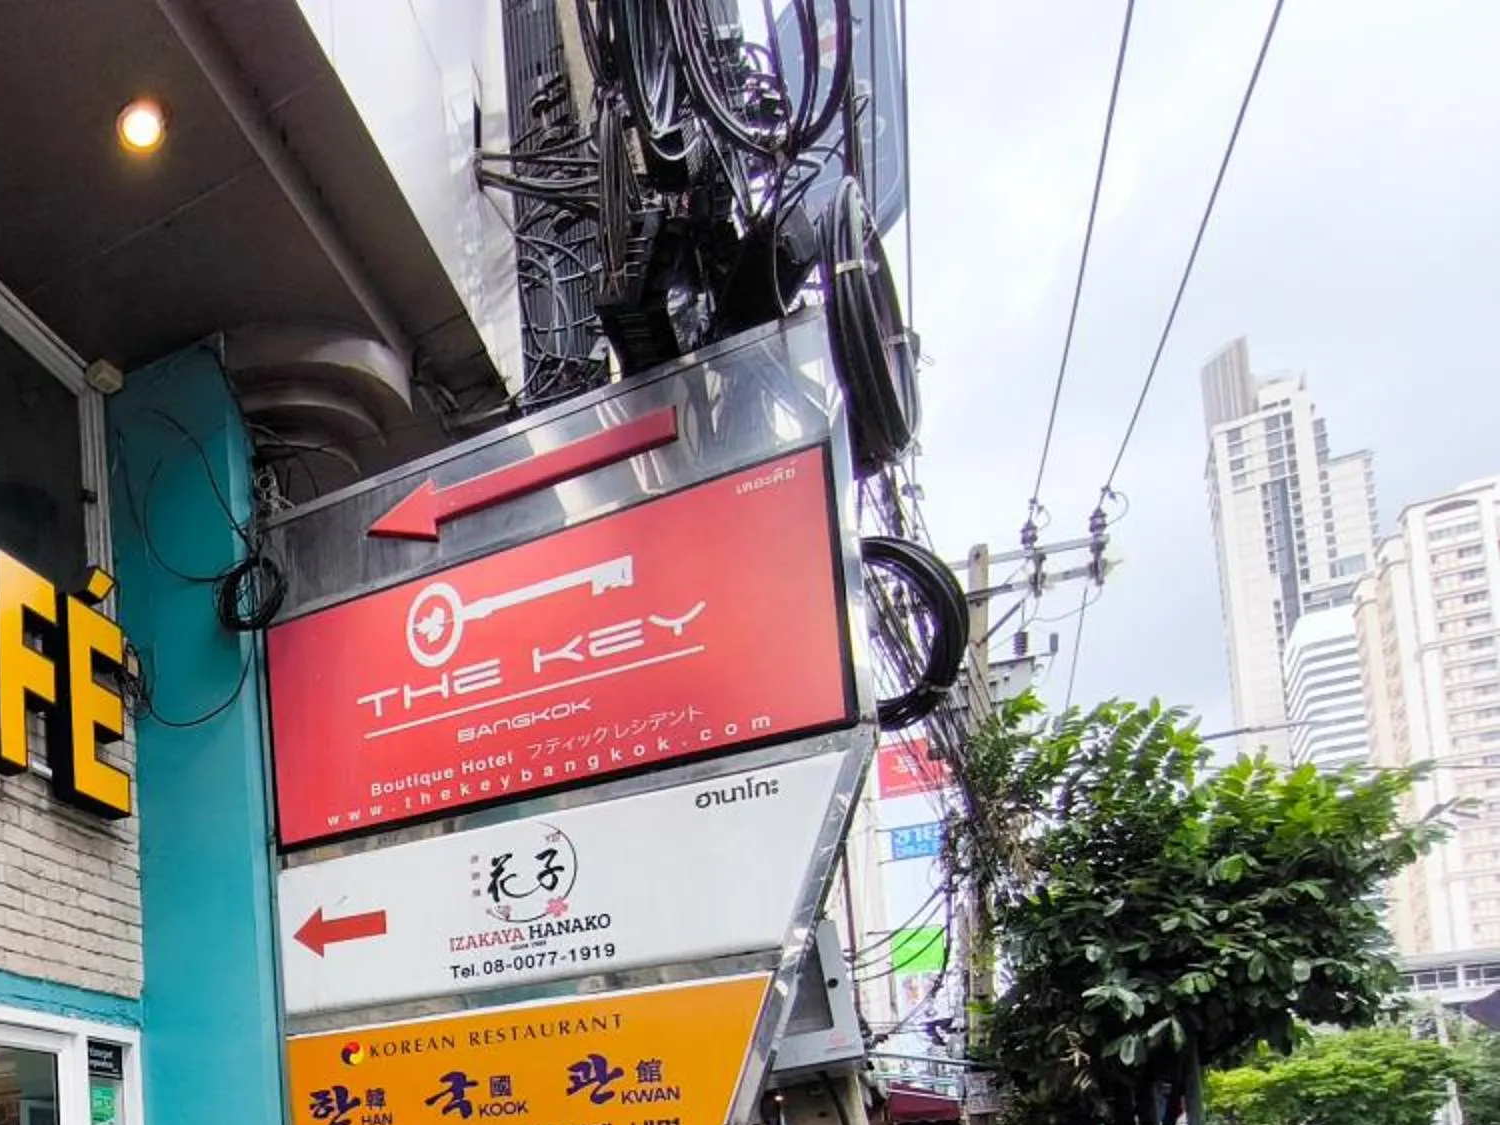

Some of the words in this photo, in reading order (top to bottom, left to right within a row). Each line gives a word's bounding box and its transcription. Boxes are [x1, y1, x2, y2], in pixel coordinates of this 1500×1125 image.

[357, 659, 503, 717] THE
[532, 601, 706, 673] KEY
[457, 697, 592, 743] BANGKOK
[371, 765, 454, 799] Boutique
[462, 752, 513, 776] Hotel
[450, 927, 526, 952] IZAKAYA
[528, 913, 612, 940] HANAKO
[369, 1034, 456, 1059] KOREAN
[468, 1012, 625, 1047] RESTAURANT
[479, 1100, 529, 1117] KOOK
[621, 1088, 681, 1106] KWAN
